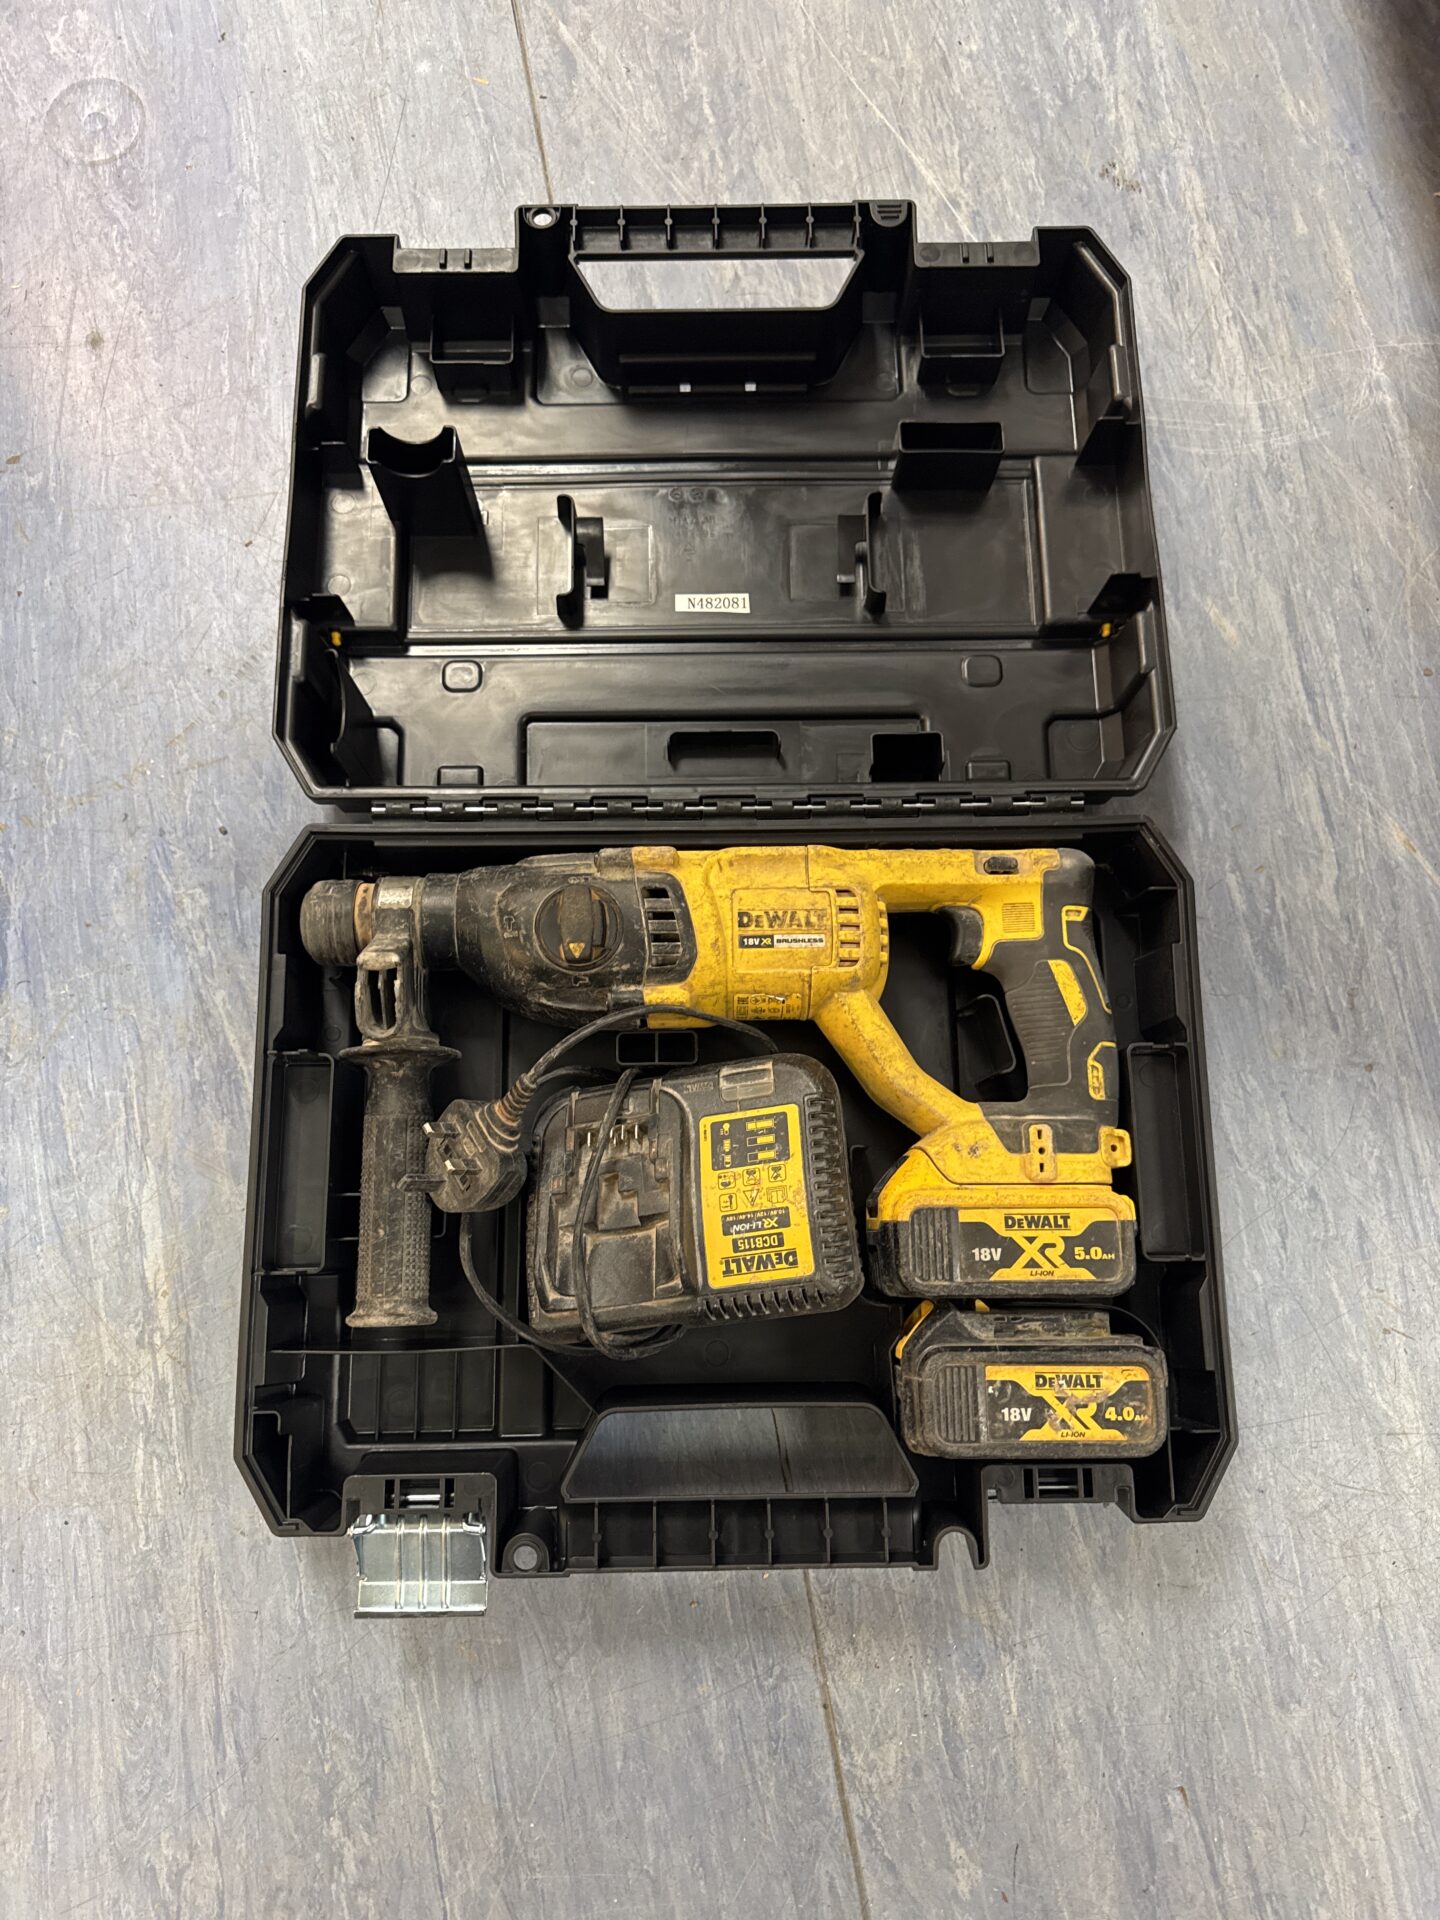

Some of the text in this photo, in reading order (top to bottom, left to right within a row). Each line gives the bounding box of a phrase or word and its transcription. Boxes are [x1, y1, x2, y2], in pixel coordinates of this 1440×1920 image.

[687, 597, 747, 609] N482081
[743, 938, 760, 946] 18V
[1004, 1215, 1070, 1229] DEWALT
[736, 1235, 778, 1251] DCB115
[971, 1247, 1002, 1261] 18V
[1012, 1235, 1068, 1269] XR
[721, 1249, 799, 1275] DEWALT
[1035, 1374, 1103, 1388] DEWALT
[1001, 1407, 1032, 1420] 18V
